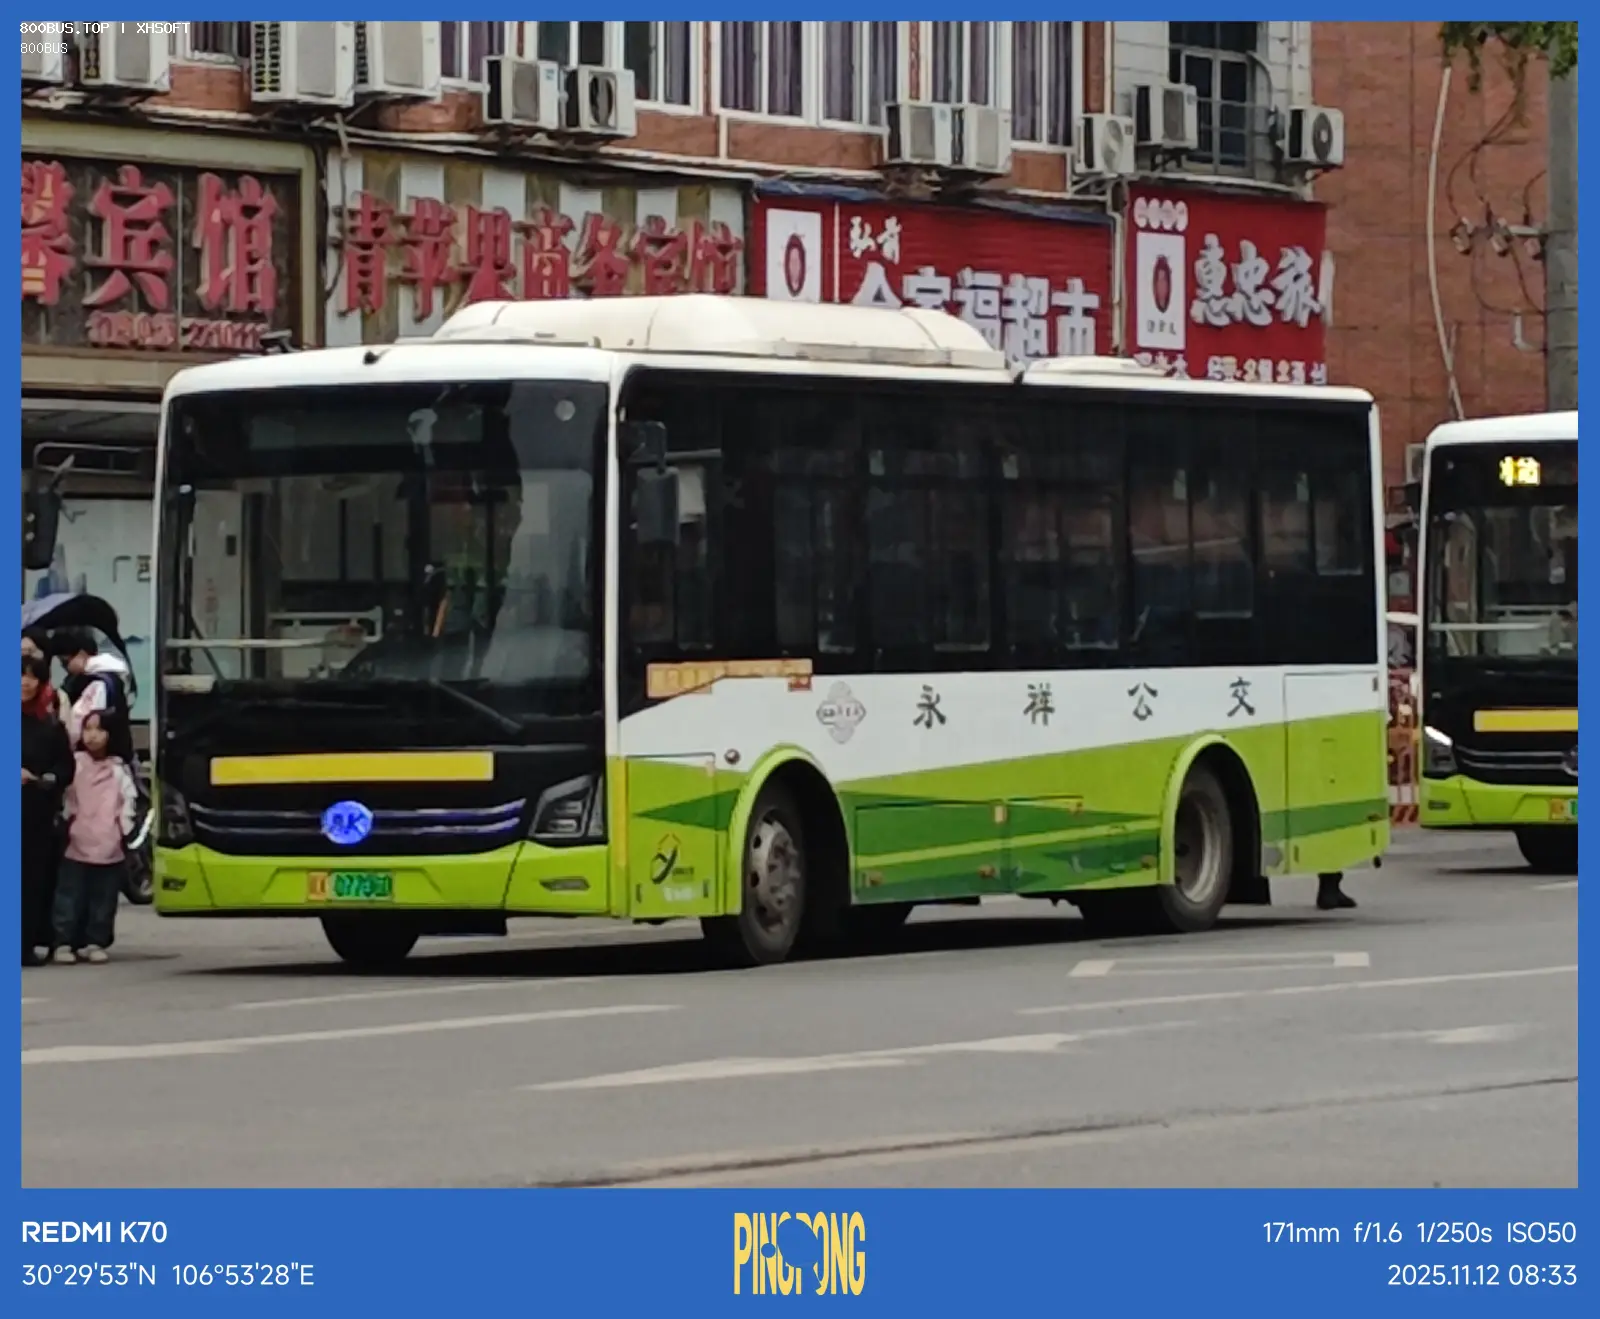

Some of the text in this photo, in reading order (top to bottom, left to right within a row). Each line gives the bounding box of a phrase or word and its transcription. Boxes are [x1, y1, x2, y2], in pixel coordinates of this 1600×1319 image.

[1190, 232, 1334, 328] 惠忠旅
[913, 676, 1256, 729] 永祥公交
